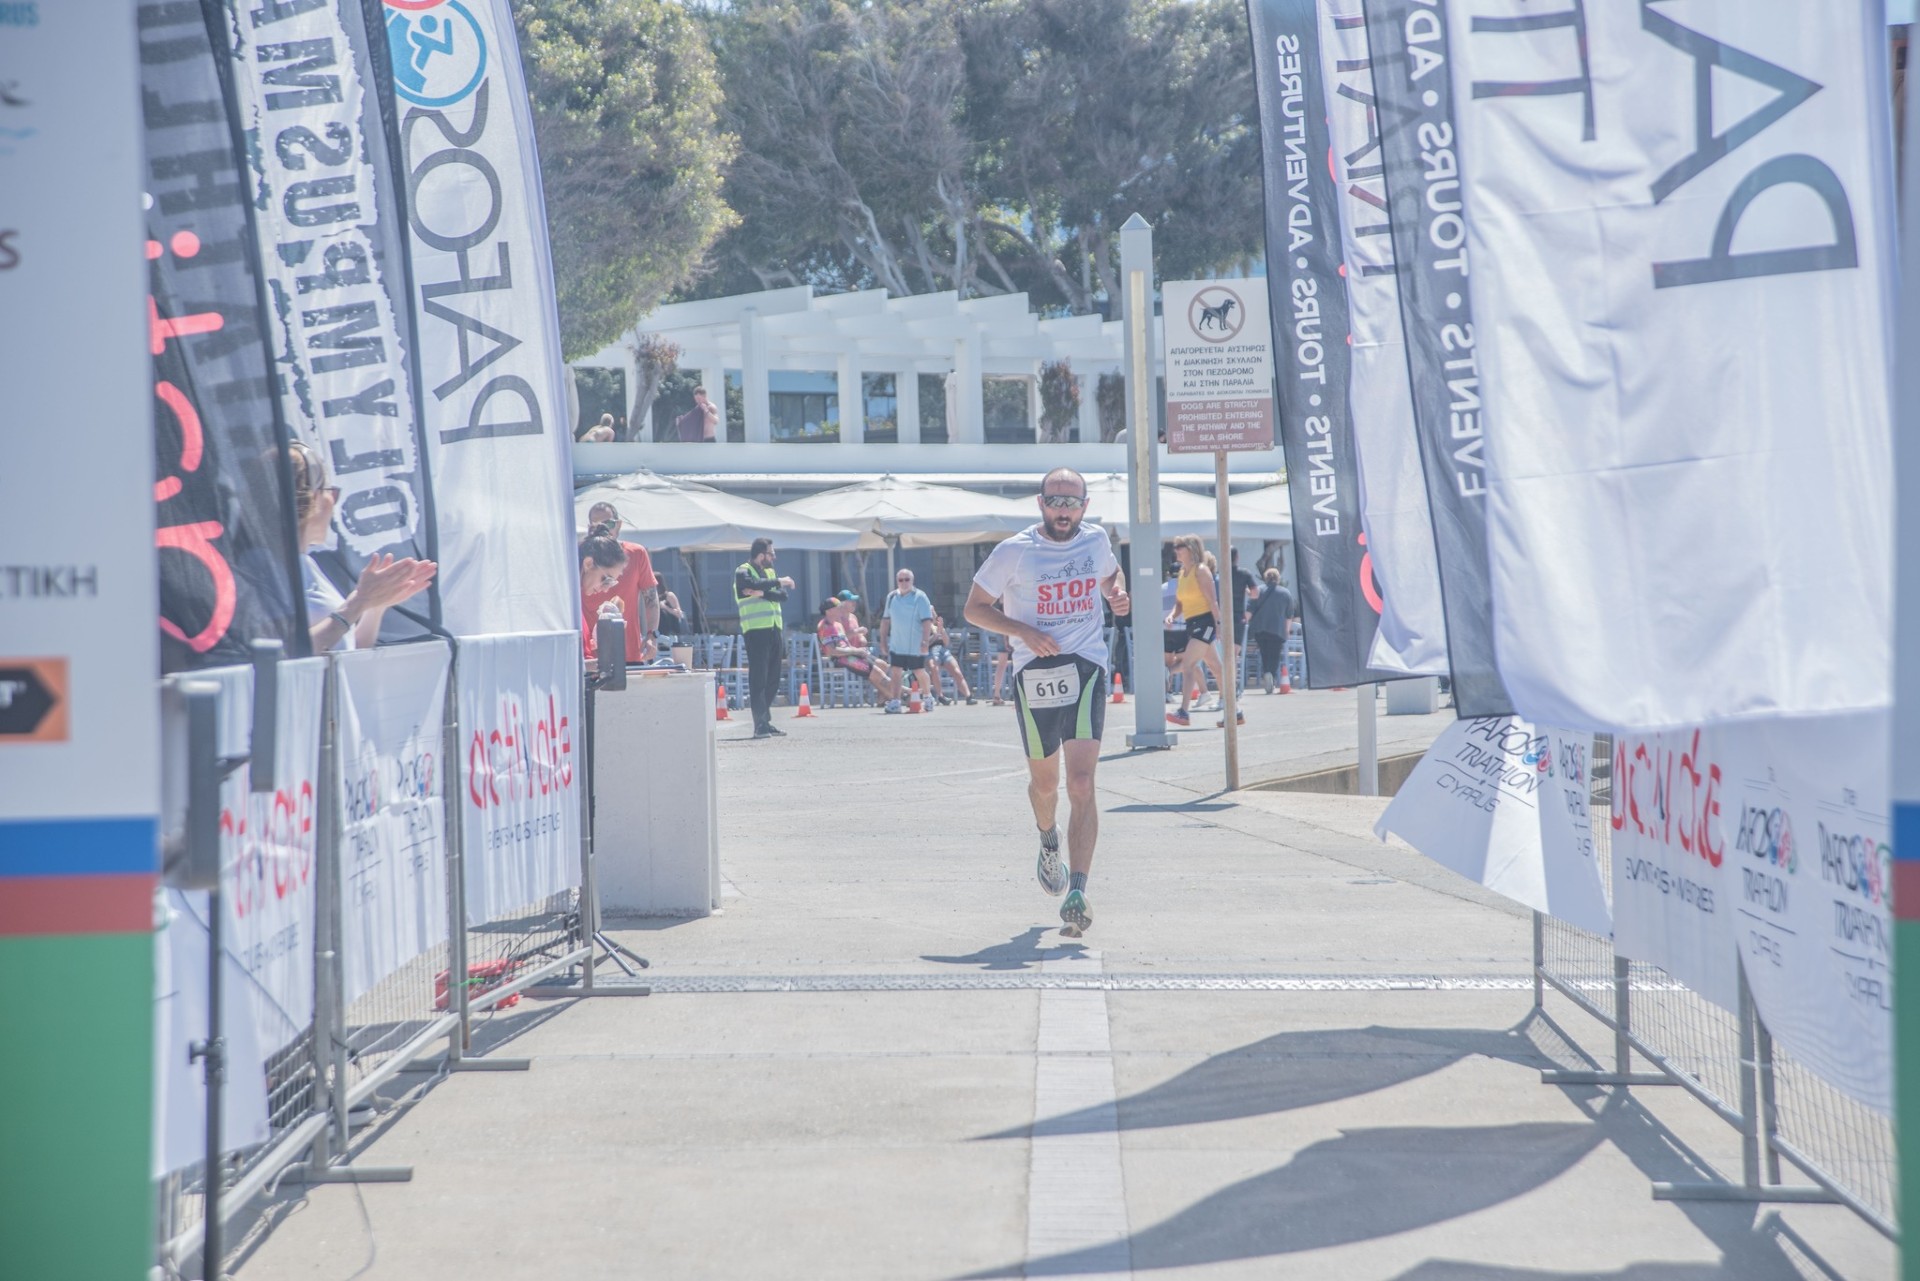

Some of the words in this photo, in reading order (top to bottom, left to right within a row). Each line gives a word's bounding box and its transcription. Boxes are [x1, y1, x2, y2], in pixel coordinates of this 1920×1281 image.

[1170, 346, 1224, 355] ΑΠΑΓΟΡΕΥΕΤΑΙ
[1228, 344, 1266, 353] ΑΥΣΤΗΡΩΣ
[1184, 358, 1223, 366] ΔΙΑΚΙΝΗΣΗ
[1183, 369, 1203, 377] ΣΤΟΝ
[1206, 367, 1254, 376] ΠΕΖΟΔΡΟΜΟ
[1183, 380, 1196, 388] ΚΑΙ
[1200, 379, 1220, 387] ΣΤΗΝ
[1223, 378, 1254, 386] ΠΑΡΑΛΙΑ
[1181, 402, 1203, 410] DOGS
[1224, 400, 1258, 408] STRICTLY
[1178, 413, 1222, 421] PROHIBITED
[1225, 411, 1263, 419] ENTERING
[1181, 424, 1195, 432] THE
[1197, 423, 1228, 431] PATHWAY
[1247, 421, 1261, 429] THE
[1217, 432, 1244, 440] SHORE
[0, 564, 98, 598] ΤΙΚΗ
[1038, 578, 1097, 602] STOP
[1037, 597, 1094, 615] BULLYING
[1036, 679, 1069, 697] 616
[1464, 717, 1549, 757] PAFOS
[1456, 742, 1544, 795] TRIATHLON
[1436, 774, 1501, 813] CYPRUS
